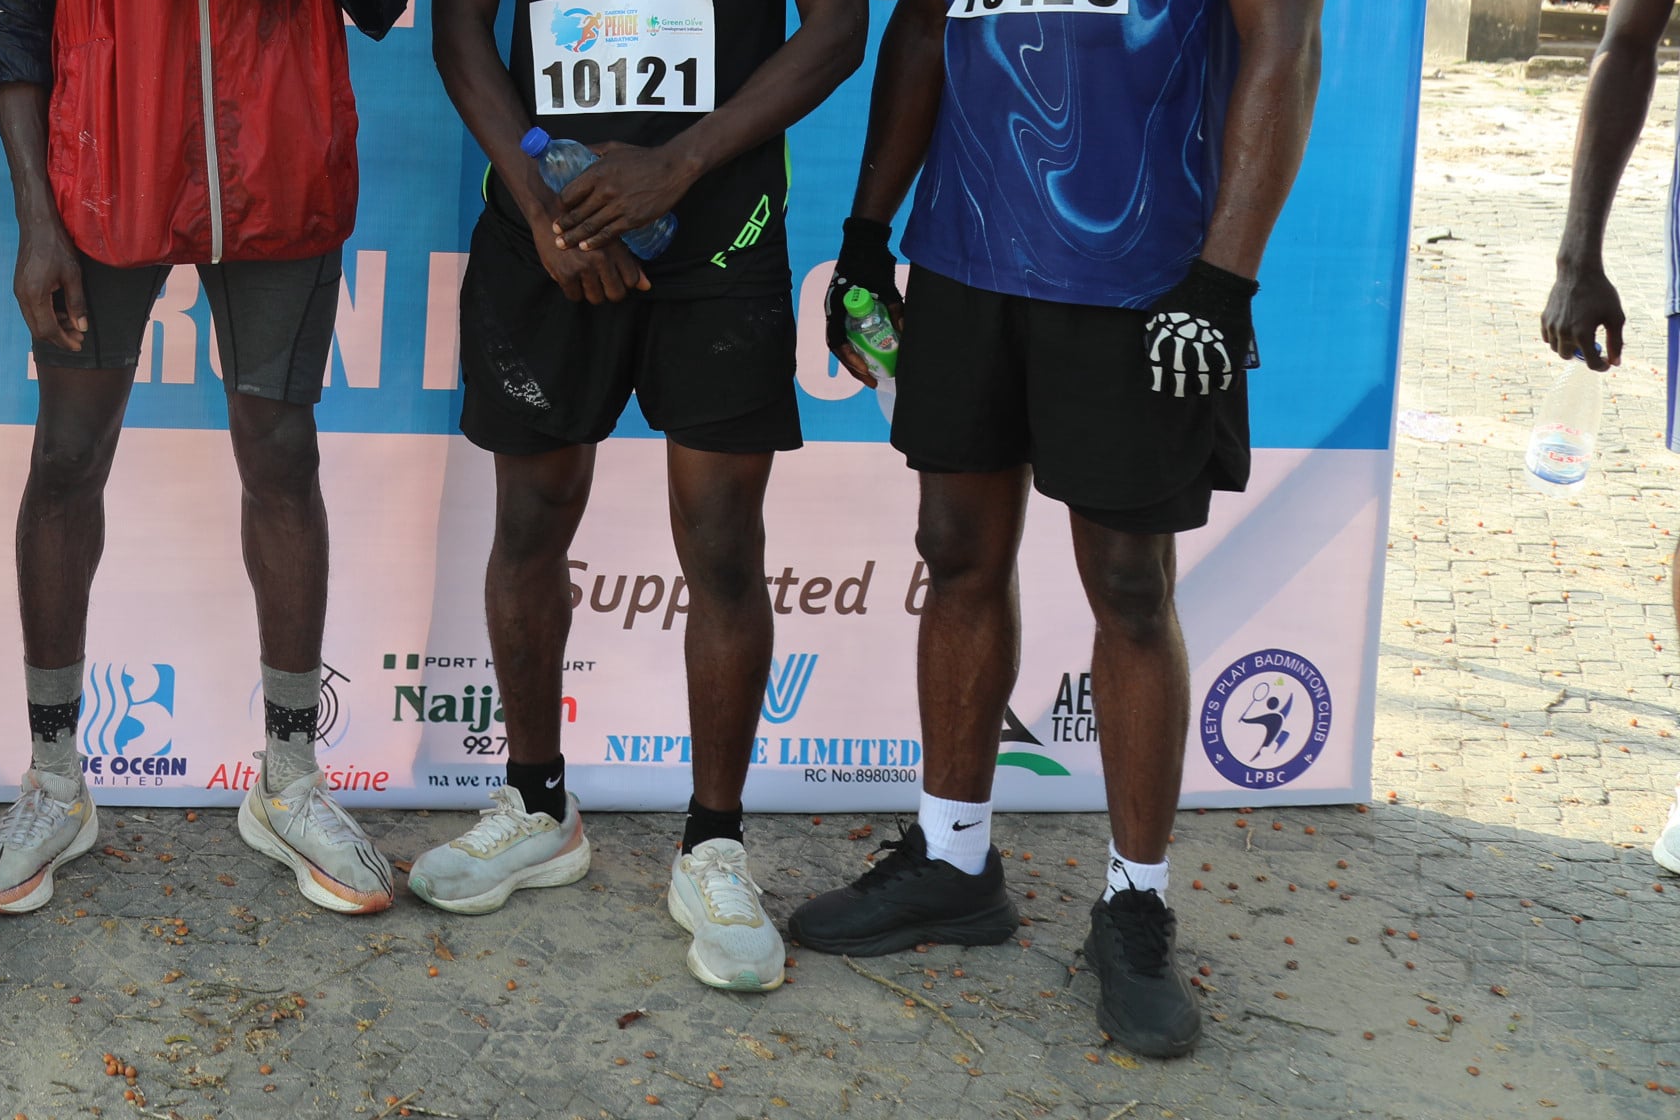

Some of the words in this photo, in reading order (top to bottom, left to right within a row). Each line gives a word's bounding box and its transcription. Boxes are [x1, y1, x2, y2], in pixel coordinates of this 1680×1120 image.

[605, 15, 639, 37] PEACE
[685, 17, 703, 26] Olive
[542, 56, 697, 108] 10121
[568, 561, 875, 630] Suppted
[425, 656, 477, 668] PORT
[1205, 700, 1220, 744] LET'S
[1216, 662, 1247, 695] PLAY
[1254, 654, 1326, 698] BADMINTON
[1314, 701, 1330, 743] CLUB
[605, 735, 767, 764] NEPTE
[778, 738, 921, 767] LIMITED
[110, 756, 187, 776] OCEAN
[804, 769, 828, 783] RC
[831, 768, 917, 783] No:8980300
[428, 774, 450, 787] na
[456, 775, 480, 787] we
[1245, 771, 1286, 783] LPBC
